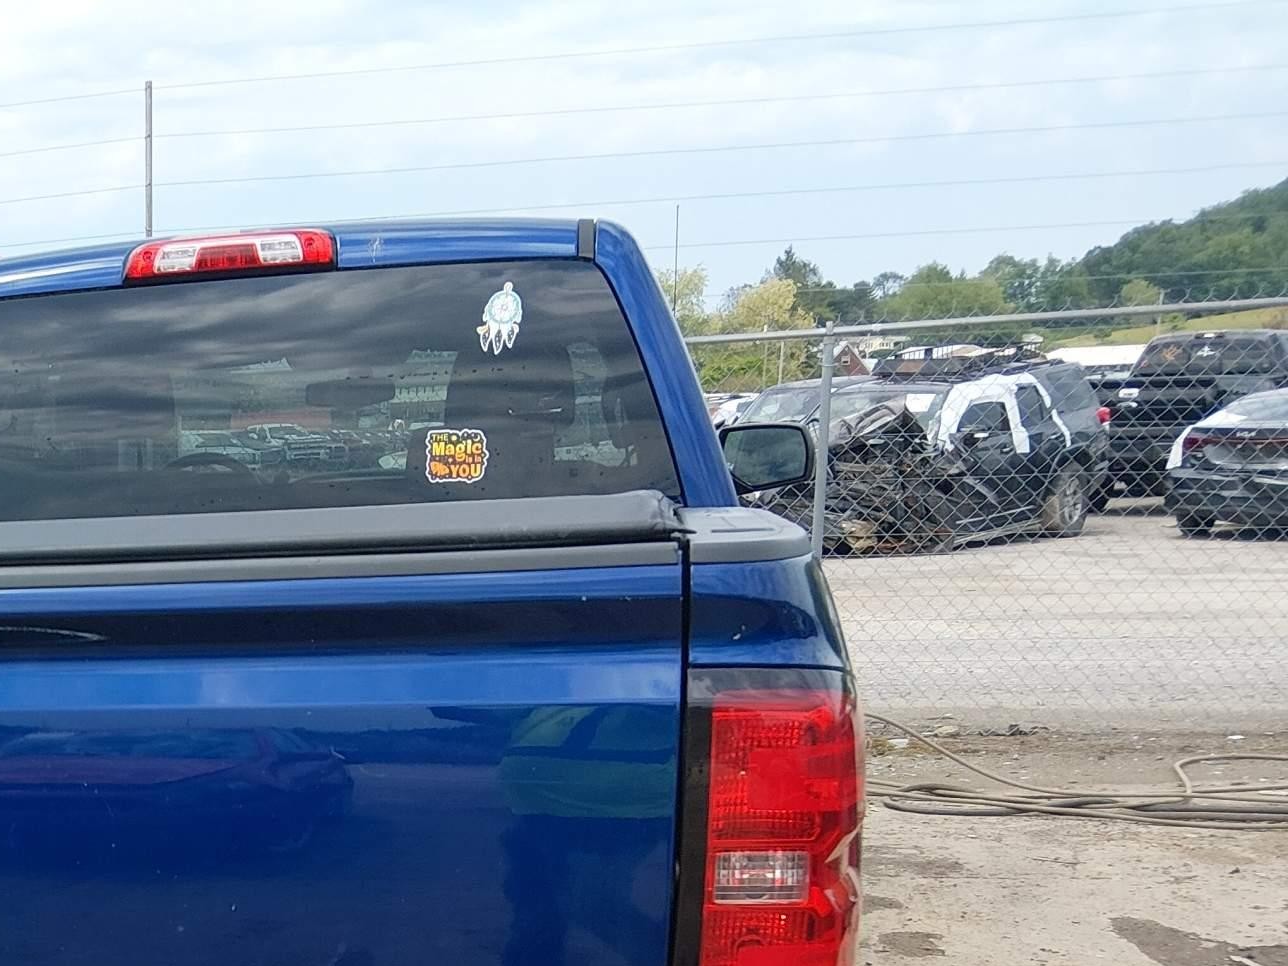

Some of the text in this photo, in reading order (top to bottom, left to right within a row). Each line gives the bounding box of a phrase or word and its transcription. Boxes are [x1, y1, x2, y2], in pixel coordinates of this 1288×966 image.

[432, 433, 448, 441] THE
[432, 439, 482, 462] Magic
[451, 463, 481, 478] YOU
